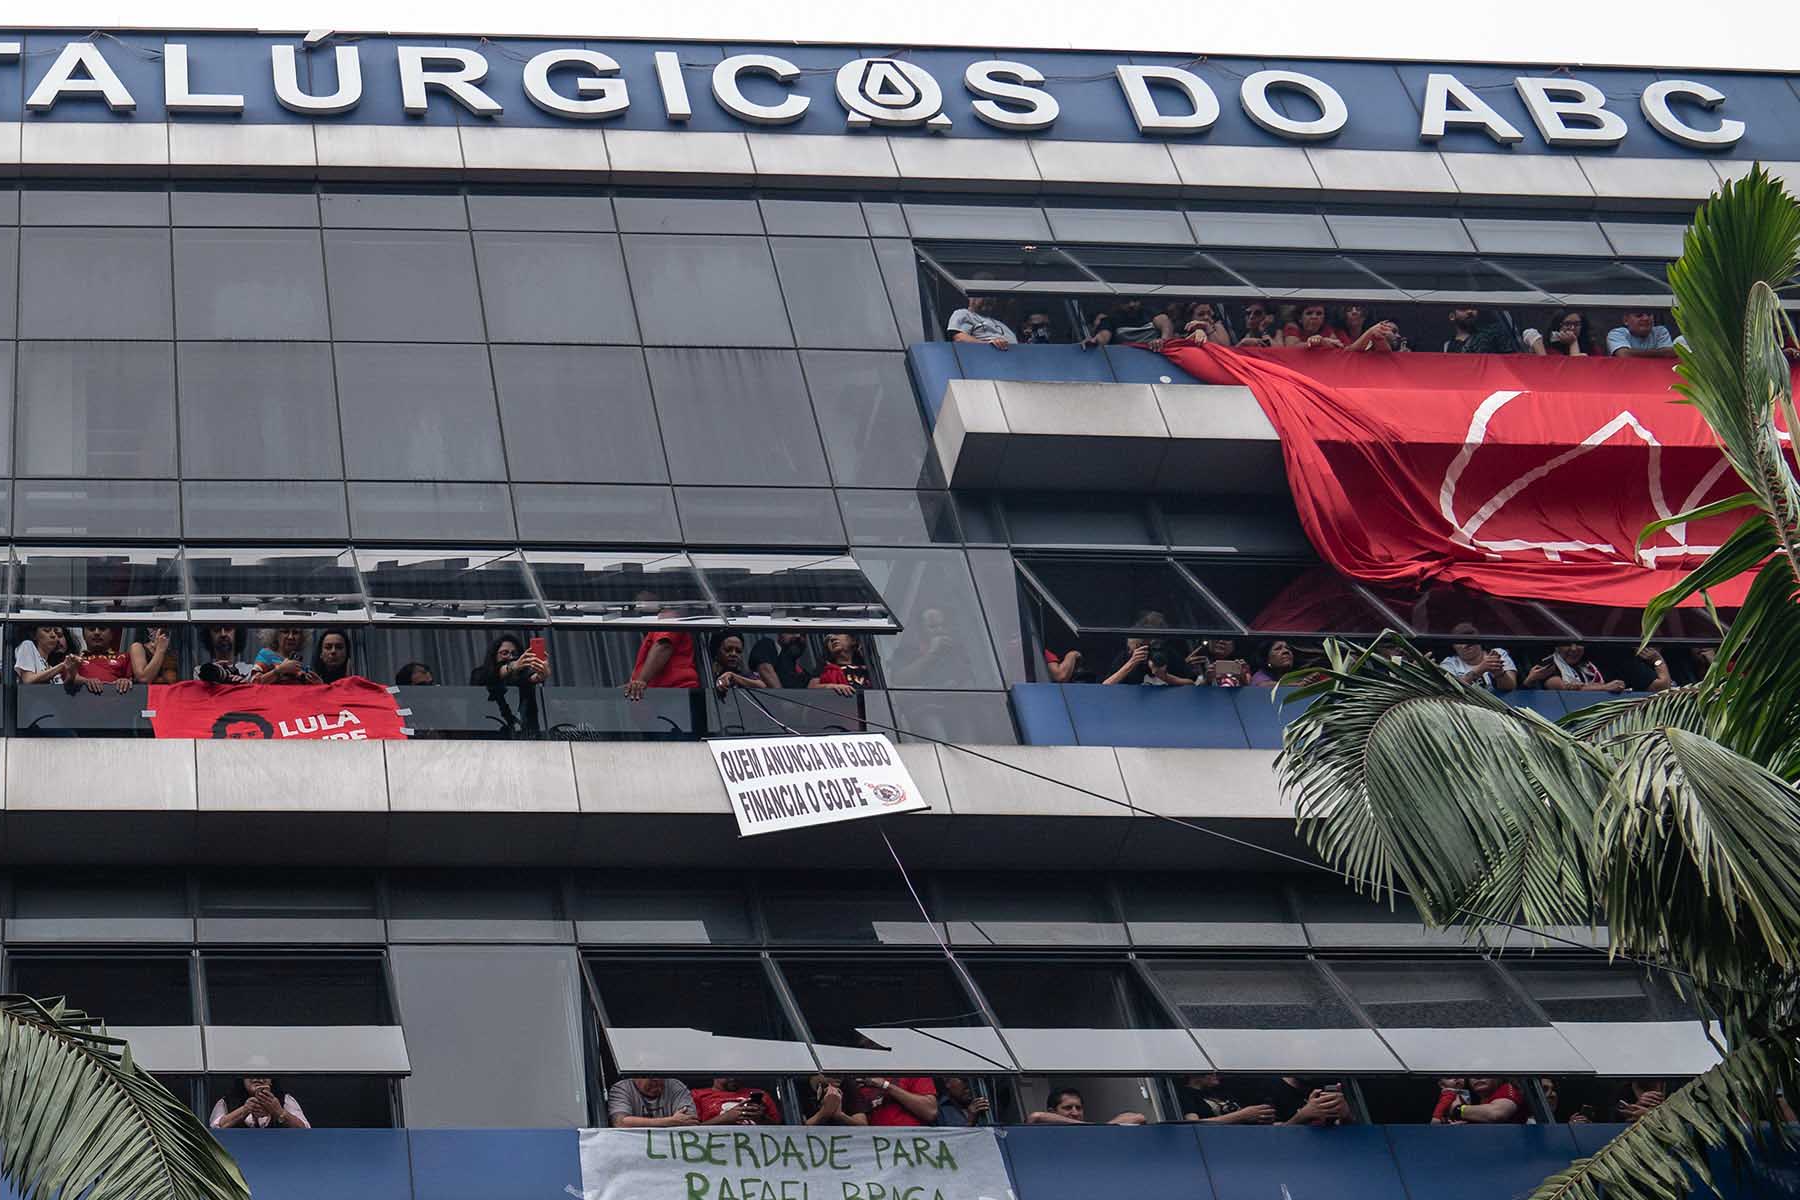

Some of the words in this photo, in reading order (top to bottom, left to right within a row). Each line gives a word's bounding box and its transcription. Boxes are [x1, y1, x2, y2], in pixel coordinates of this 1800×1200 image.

[1115, 64, 1349, 142] DO
[1420, 73, 1746, 150] ABC
[278, 709, 361, 737] LULA
[720, 748, 766, 784] QUEM
[760, 743, 827, 776] ANUNCIA
[819, 742, 846, 769] NA
[842, 740, 892, 768] GLOBO
[737, 783, 810, 824] FINANCIA
[805, 781, 821, 814] O
[819, 776, 869, 812] GOLPE
[646, 1129, 854, 1171] LIBERDADE
[872, 1135, 959, 1171] PARA
